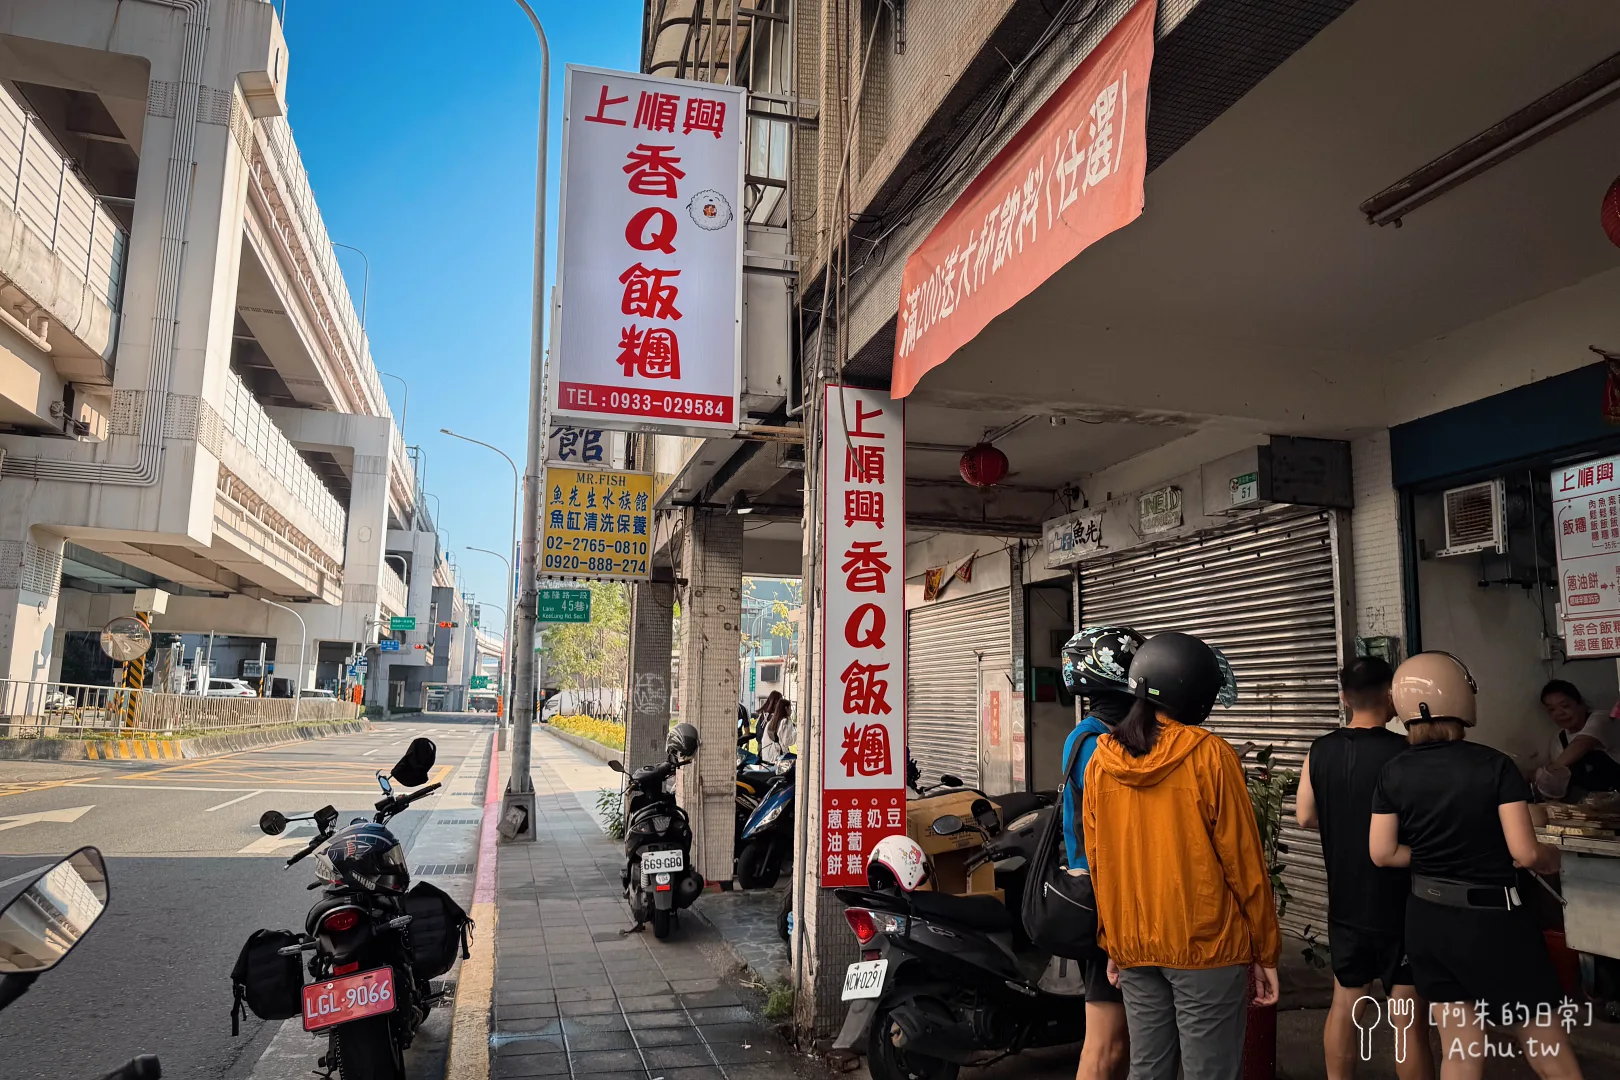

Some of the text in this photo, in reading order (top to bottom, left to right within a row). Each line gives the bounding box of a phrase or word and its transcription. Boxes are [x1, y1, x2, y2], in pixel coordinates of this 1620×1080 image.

[584, 84, 726, 139] 上順興
[616, 143, 686, 380] 香Q飯糰
[566, 387, 724, 417] TEL:0933-029584
[576, 472, 626, 487] MR.FISH
[1559, 462, 1614, 493] 上順興
[550, 484, 649, 512] 魚先生水族館
[550, 510, 647, 536] 魚缸清洗保養
[546, 536, 647, 555] 02-2765-0810
[545, 554, 646, 574] 0920-888-274
[562, 600, 585, 611] 45巷
[644, 857, 682, 870] 669-GBQ
